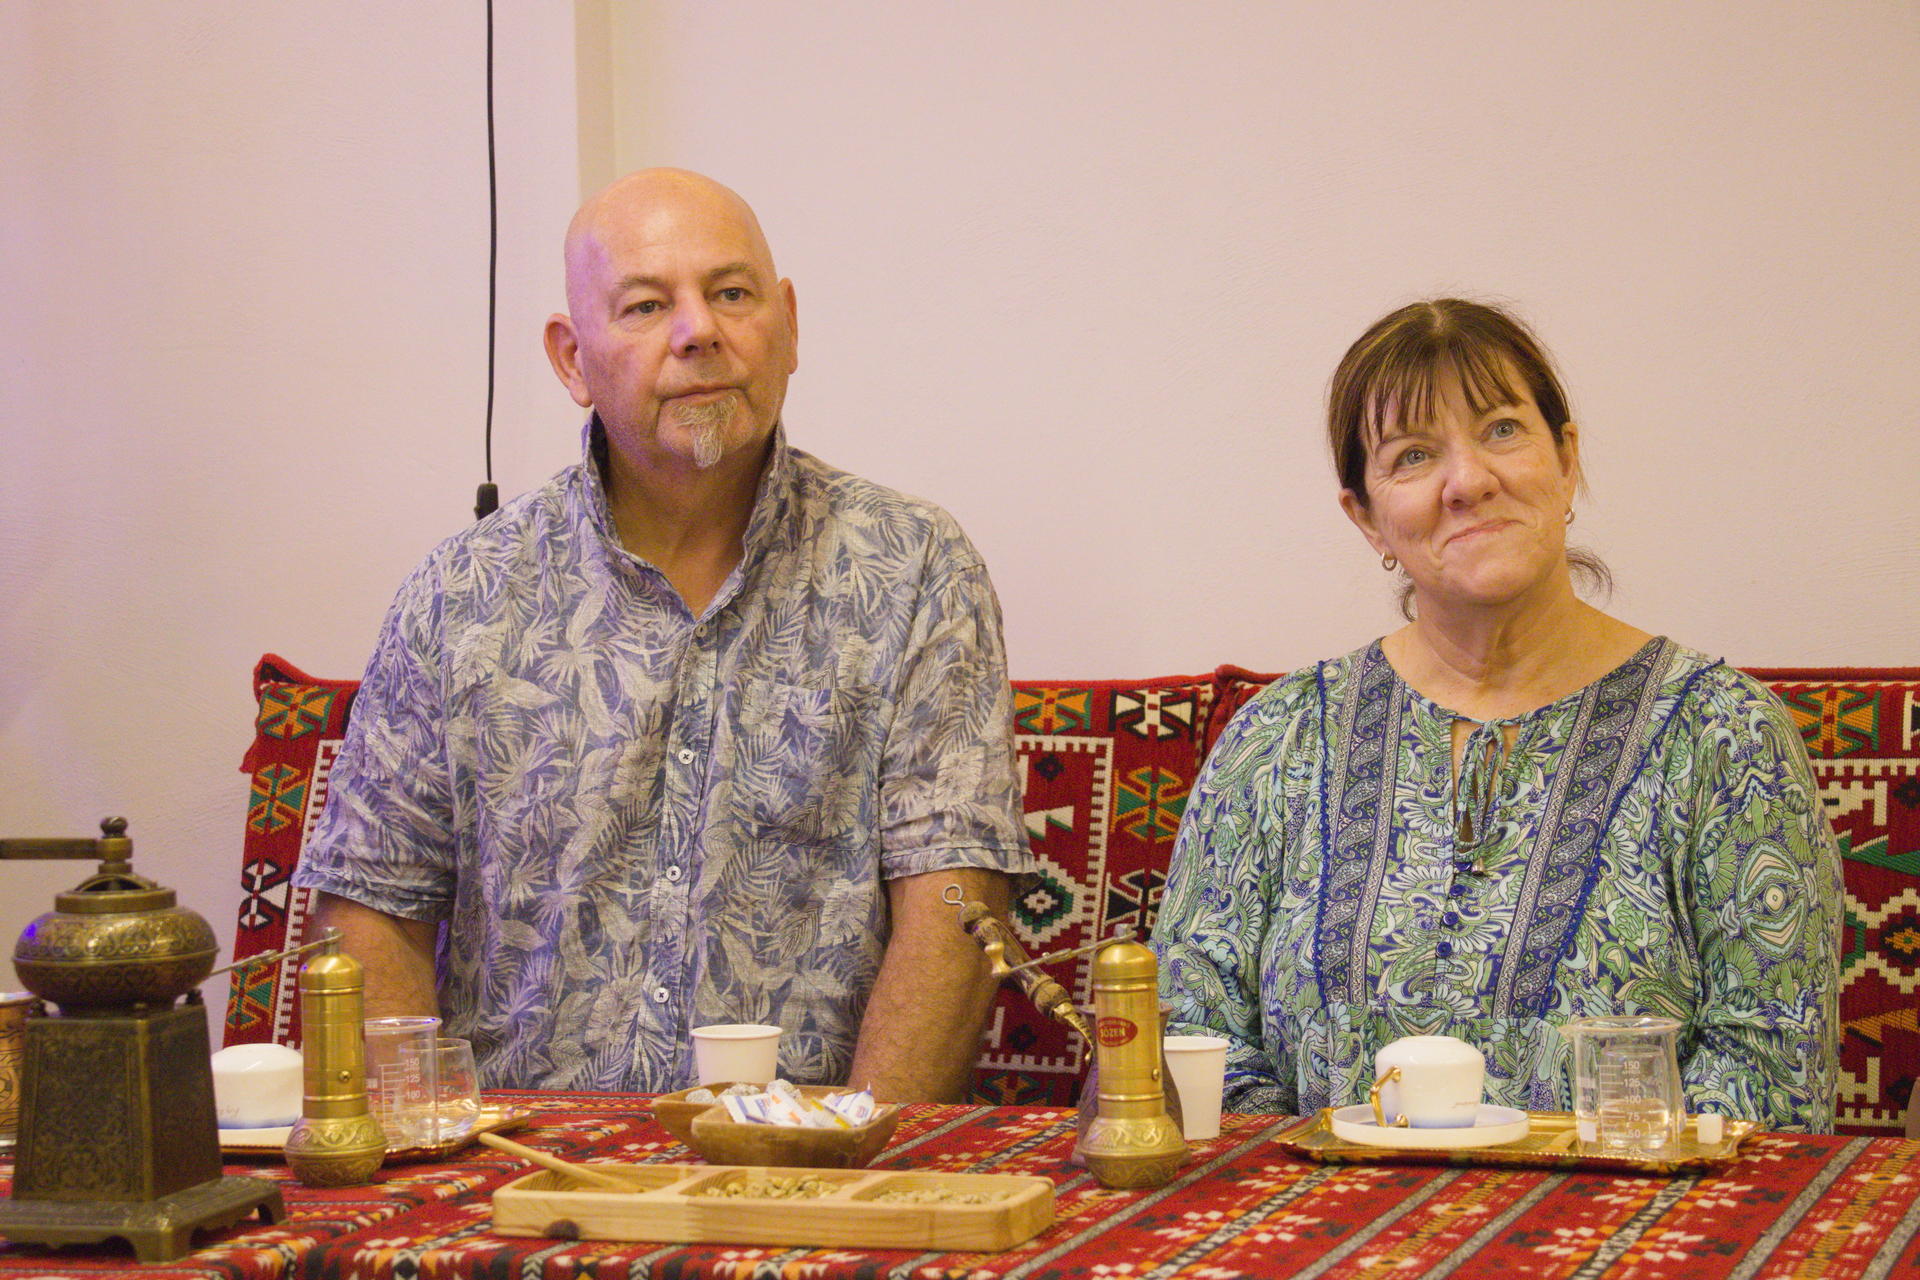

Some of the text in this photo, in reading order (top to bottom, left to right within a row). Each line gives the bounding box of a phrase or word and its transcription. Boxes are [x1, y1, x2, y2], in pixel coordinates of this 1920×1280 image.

[1624, 1061, 1640, 1070] 150
[1624, 1078, 1641, 1088] 125
[1625, 1095, 1642, 1104] 100
[1628, 1112, 1640, 1121] 75
[1628, 1129, 1641, 1138] 50
